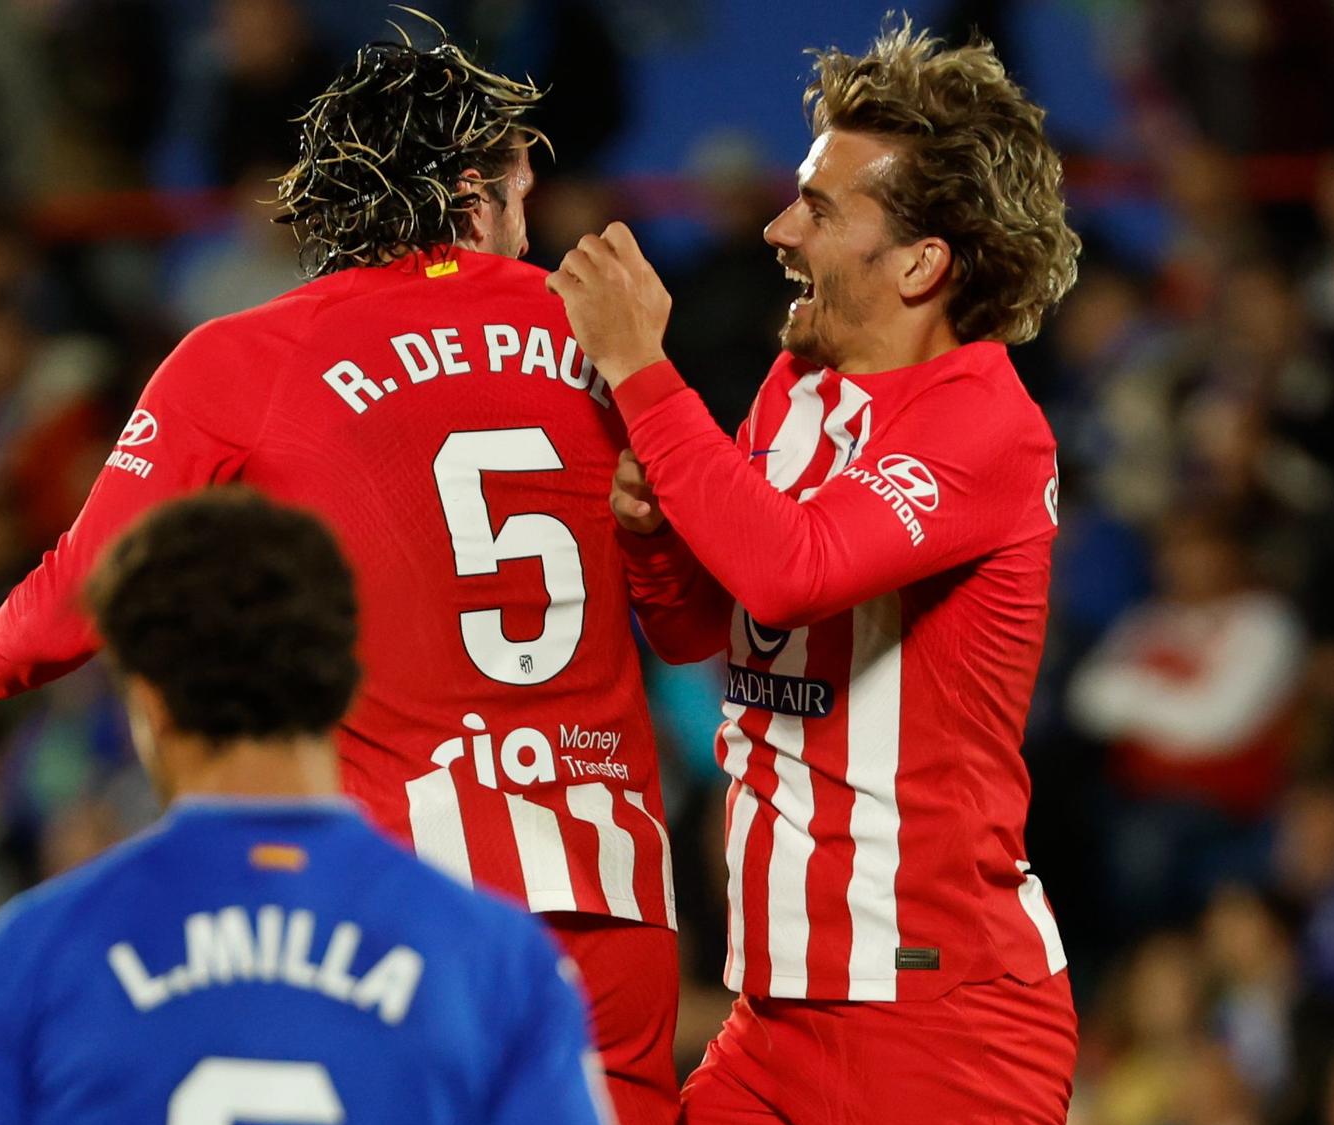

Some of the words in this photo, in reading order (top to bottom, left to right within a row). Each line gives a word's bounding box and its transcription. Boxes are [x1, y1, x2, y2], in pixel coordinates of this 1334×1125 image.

[321, 359, 400, 415] R.
[389, 327, 472, 385] DE
[841, 465, 926, 548] HYUNDAI
[432, 426, 587, 686] 5
[727, 670, 775, 707] YADH
[779, 681, 826, 714] AIR
[429, 712, 557, 790] ria
[559, 723, 622, 757] Money
[560, 755, 631, 781] Transfer
